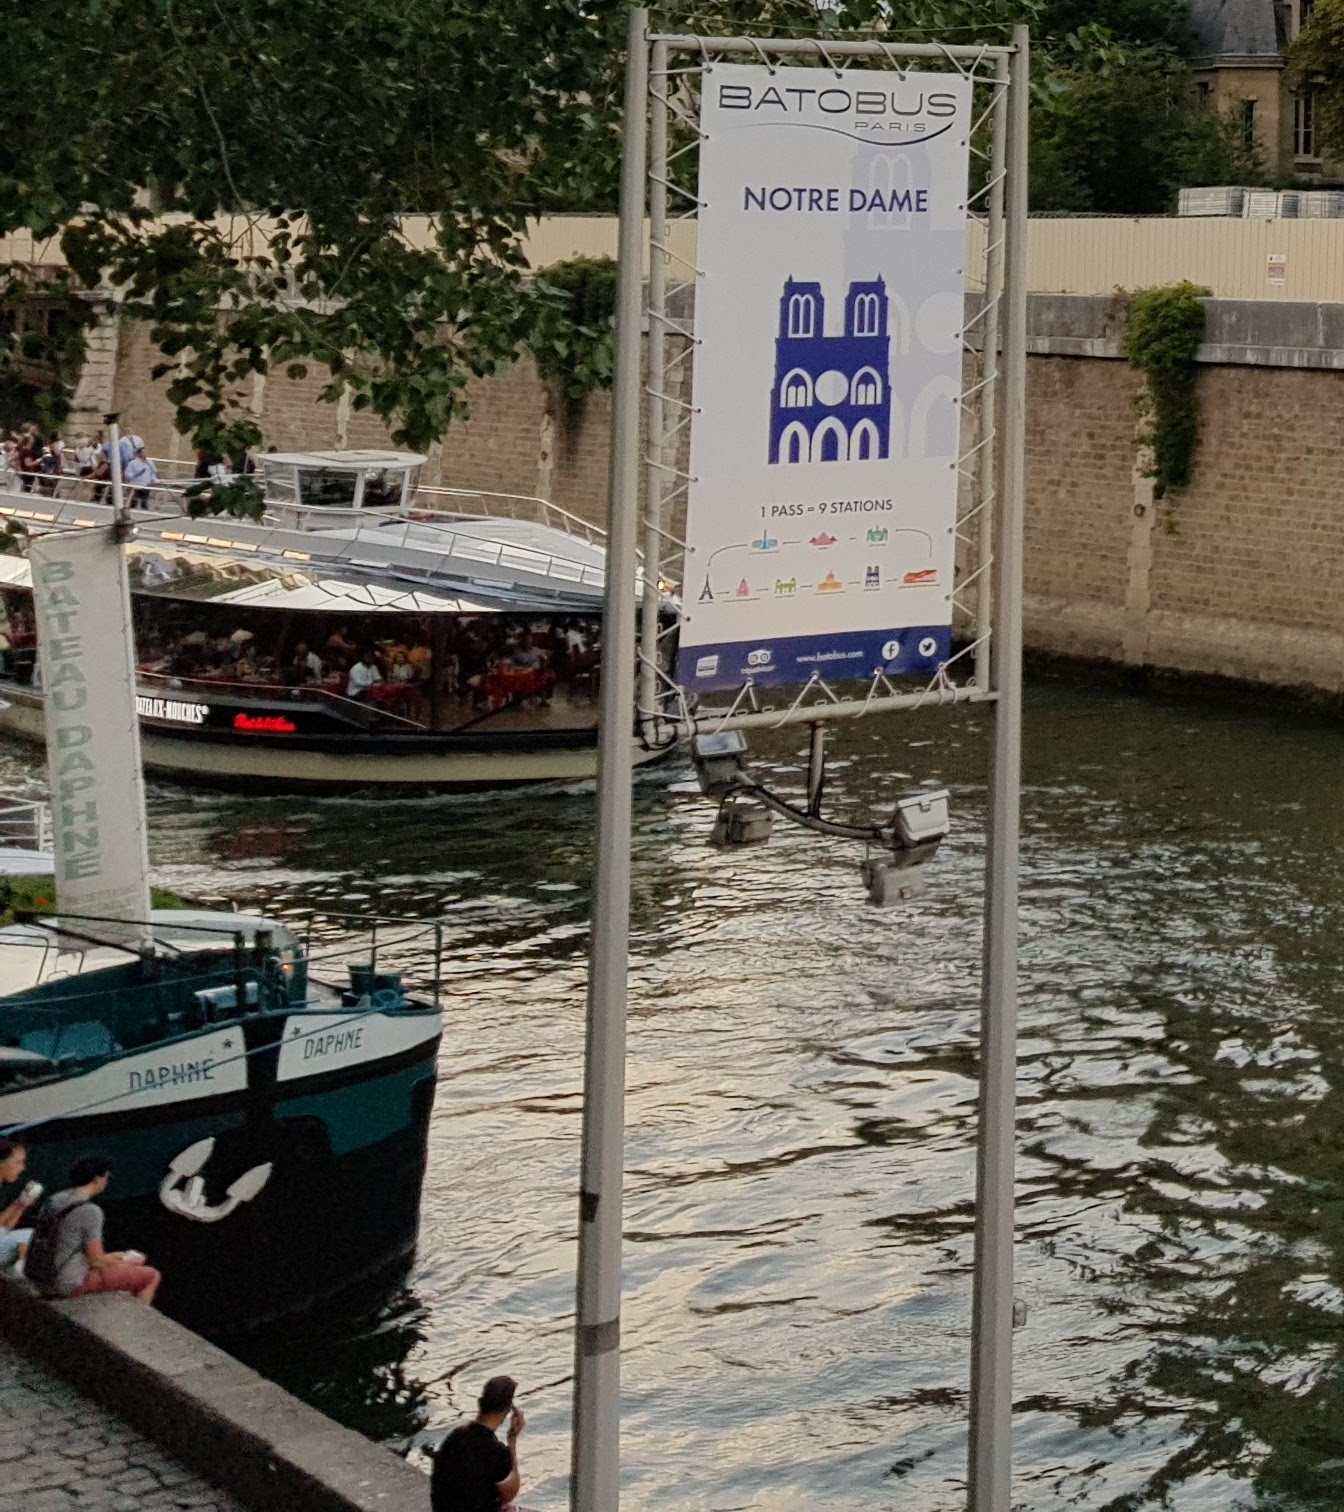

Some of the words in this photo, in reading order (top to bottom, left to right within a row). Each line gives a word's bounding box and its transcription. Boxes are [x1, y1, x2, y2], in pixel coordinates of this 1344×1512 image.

[719, 84, 957, 117] BATOBUS
[854, 121, 926, 132] PARIS
[744, 186, 839, 212] NOTRE
[849, 189, 928, 213] DAME
[760, 506, 766, 518] 1
[771, 503, 804, 518] PASS
[818, 502, 827, 515] 9
[830, 499, 893, 514] STATIONS
[39, 561, 88, 711] BATEAU
